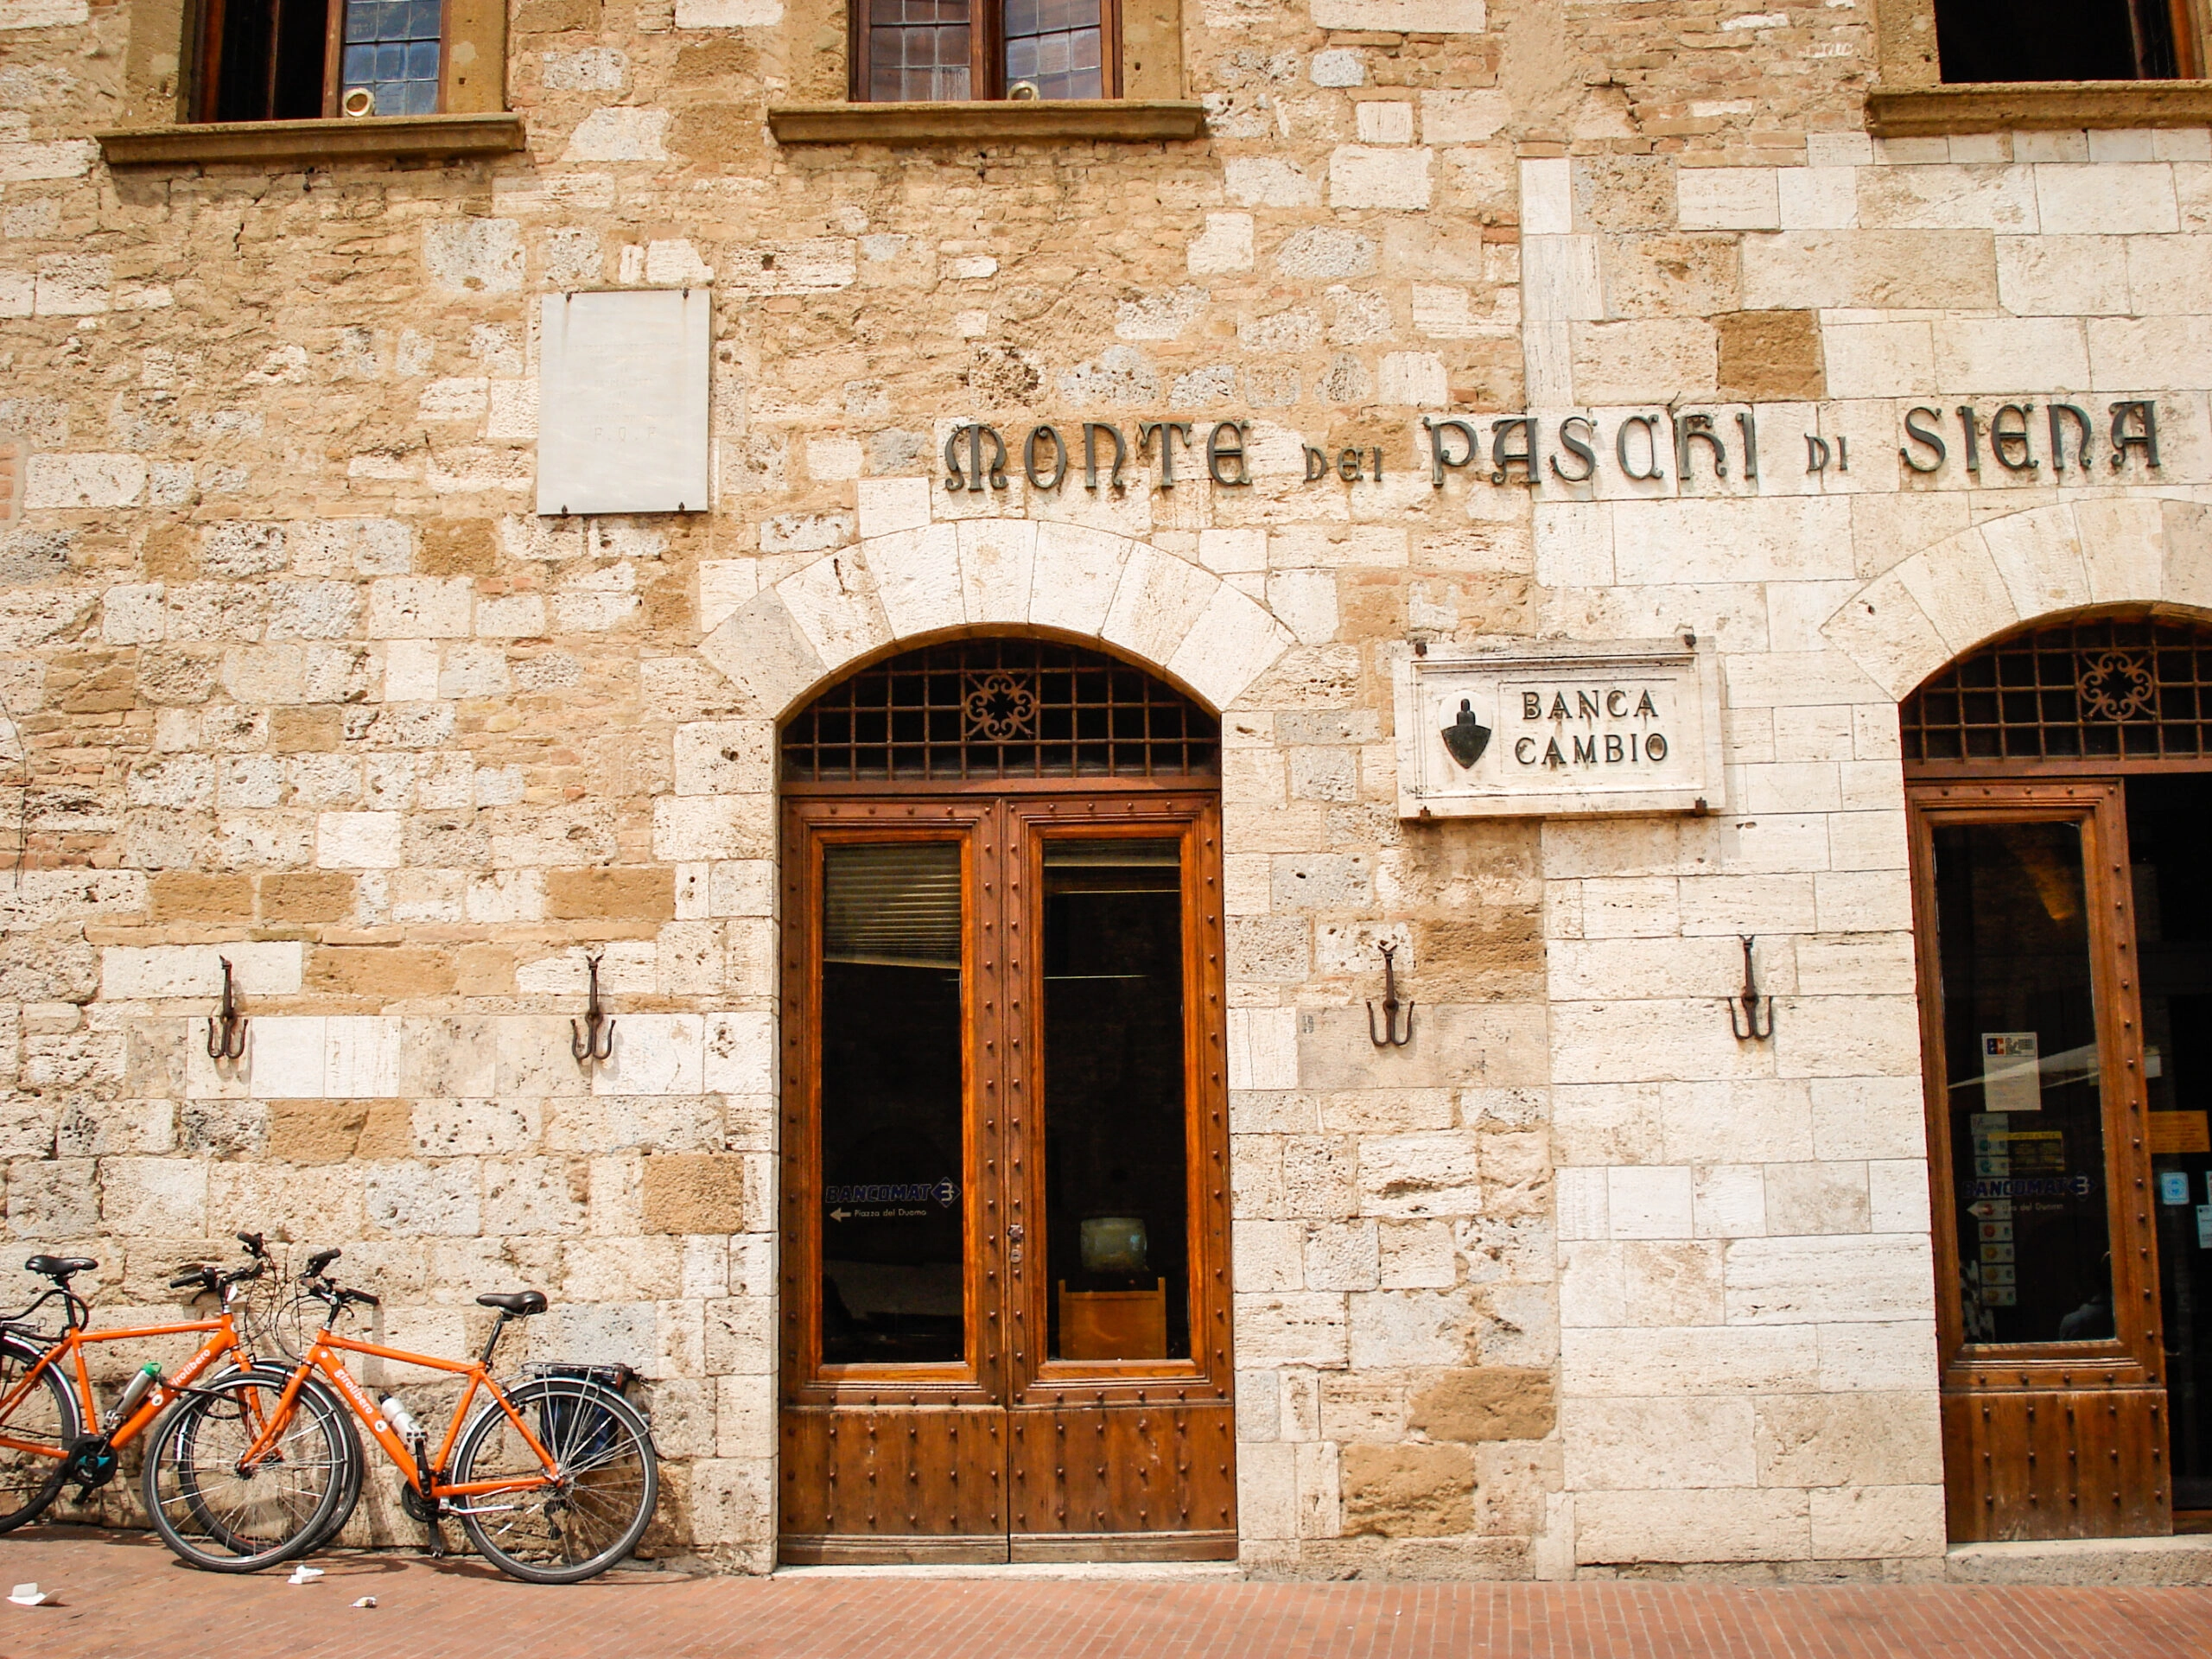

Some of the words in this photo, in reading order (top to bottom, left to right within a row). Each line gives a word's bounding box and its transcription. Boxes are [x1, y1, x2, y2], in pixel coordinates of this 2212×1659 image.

[945, 420, 1253, 491] MONTE
[1300, 442, 1382, 483] DEI
[1422, 412, 1758, 487] PASCHI
[1803, 433, 1848, 474] DI
[1900, 401, 2161, 473] SIENA
[1521, 690, 1659, 721] BANCA
[1514, 733, 1669, 766] CAMBIO
[825, 1184, 932, 1204] BANCOMAT
[882, 1209, 895, 1217] del
[898, 1208, 927, 1217] Duomo
[170, 1349, 211, 1389] irolibero
[334, 1369, 373, 1414] girolibero
